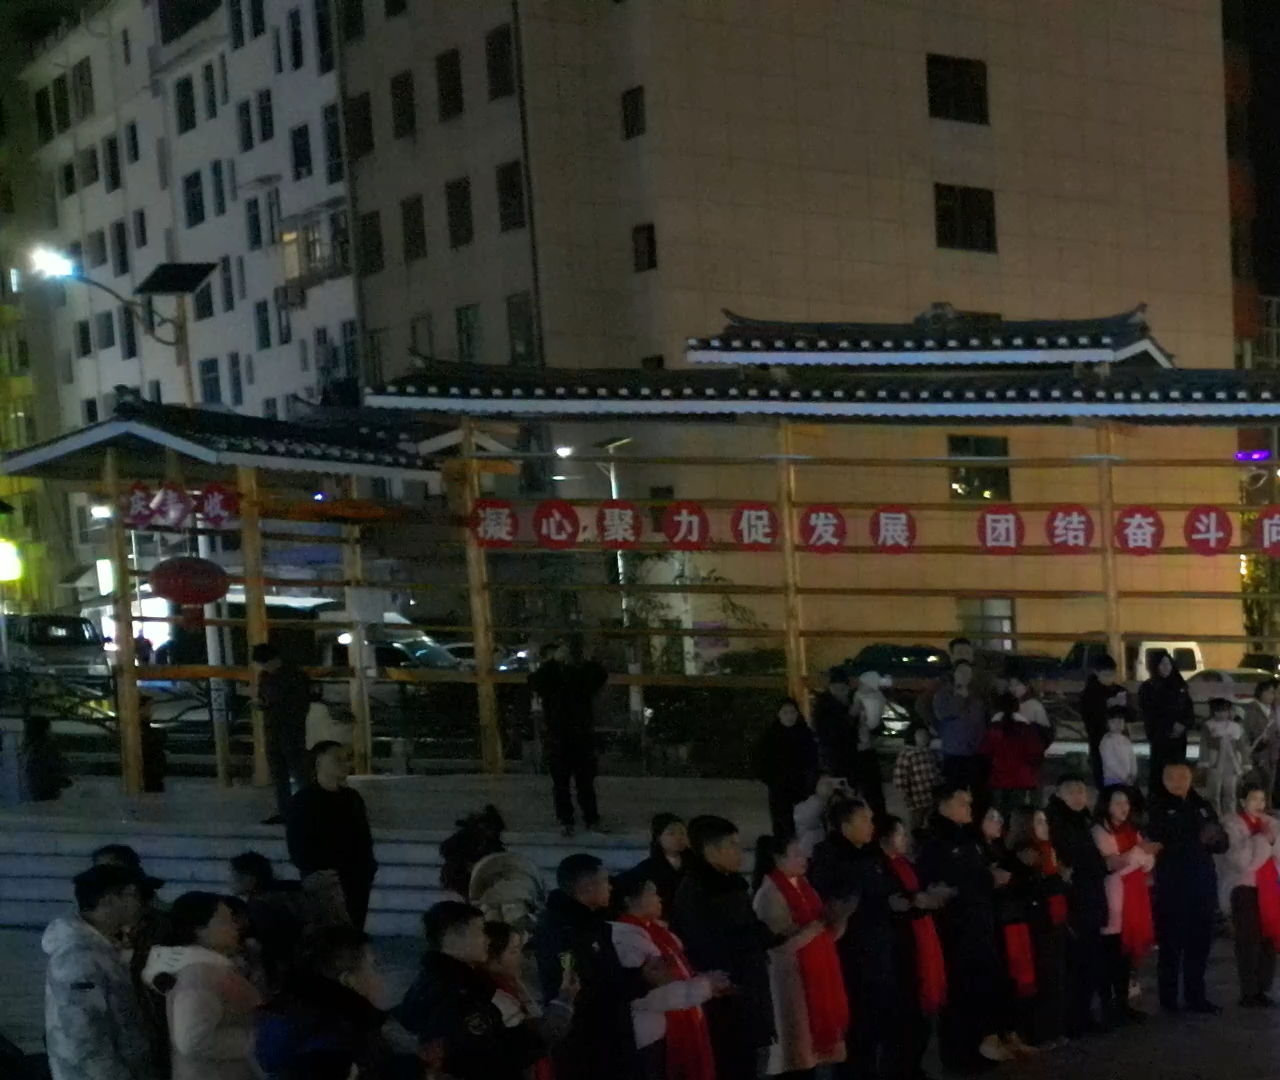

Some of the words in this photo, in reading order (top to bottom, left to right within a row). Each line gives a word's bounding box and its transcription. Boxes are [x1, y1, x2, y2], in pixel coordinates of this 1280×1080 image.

[476, 507, 917, 546] 凝心聚力促发展
